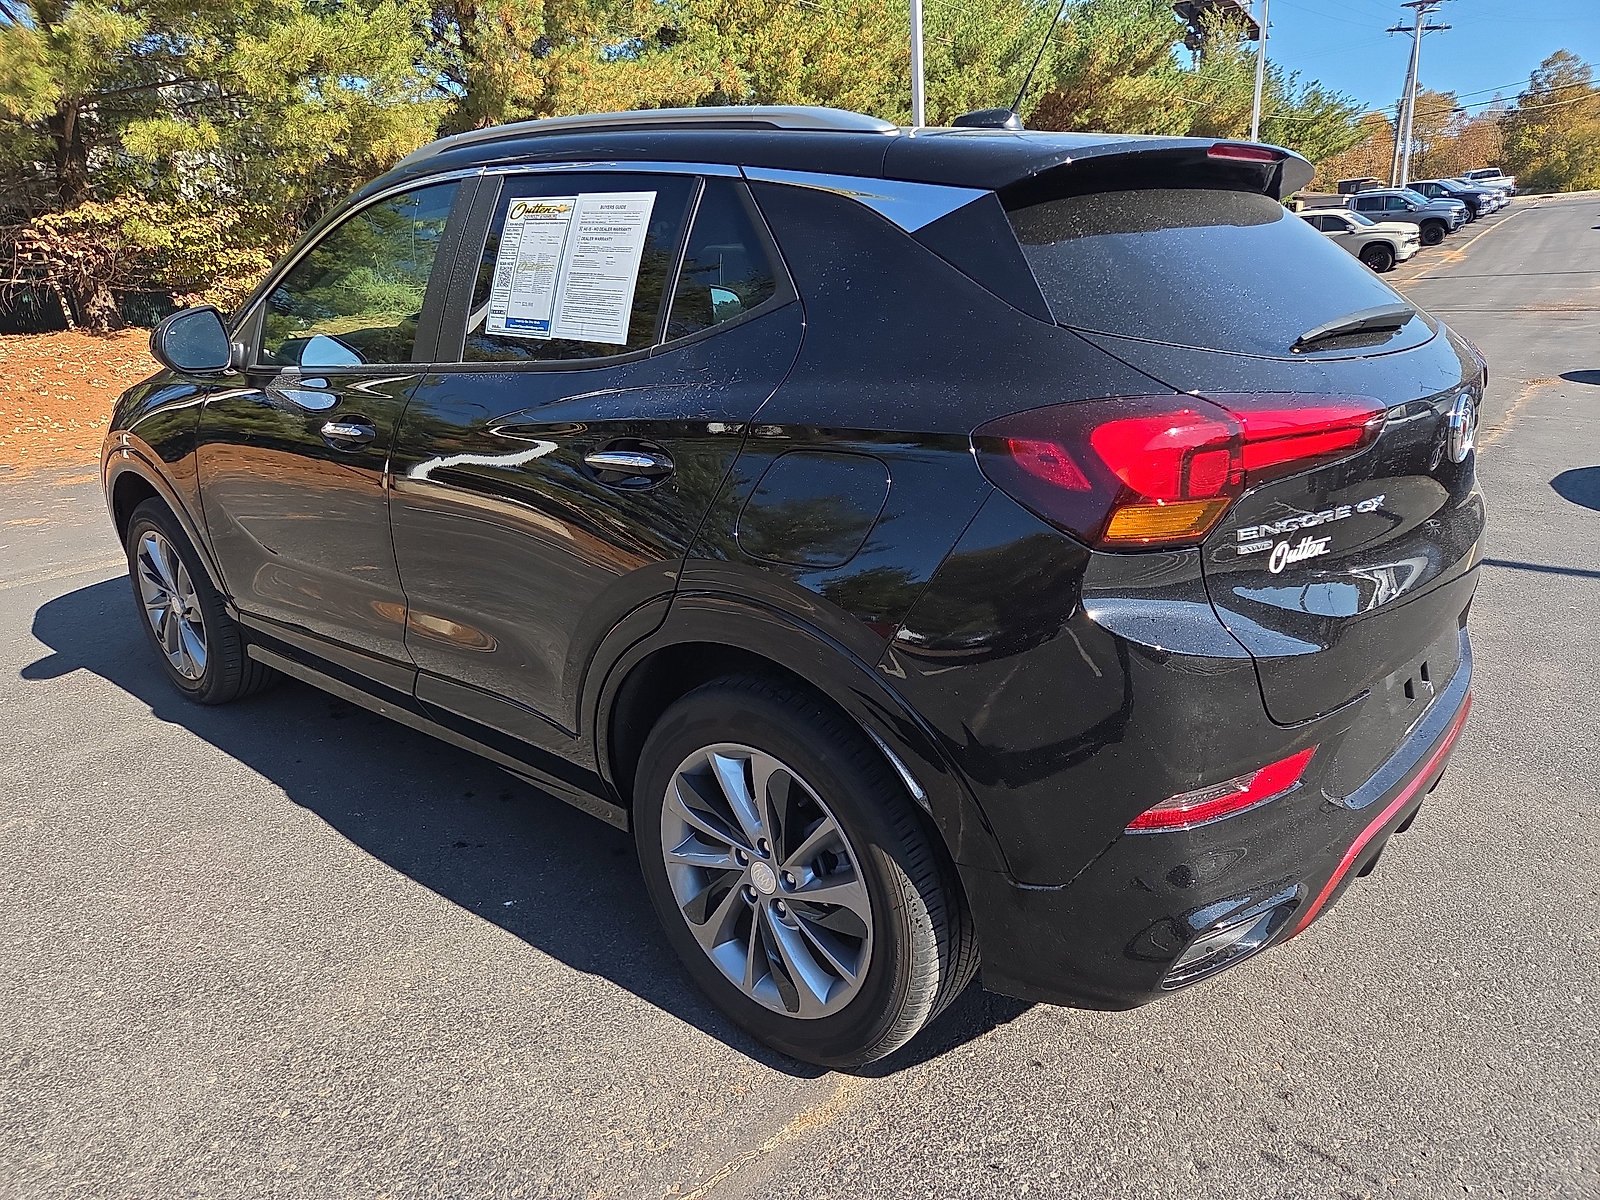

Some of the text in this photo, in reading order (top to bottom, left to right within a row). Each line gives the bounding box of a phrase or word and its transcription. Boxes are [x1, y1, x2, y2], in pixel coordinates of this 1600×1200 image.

[510, 202, 556, 219] Outten
[1236, 493, 1386, 542] ENCORE GX
[1237, 540, 1273, 555] AWD
[1269, 535, 1332, 574] Outten
